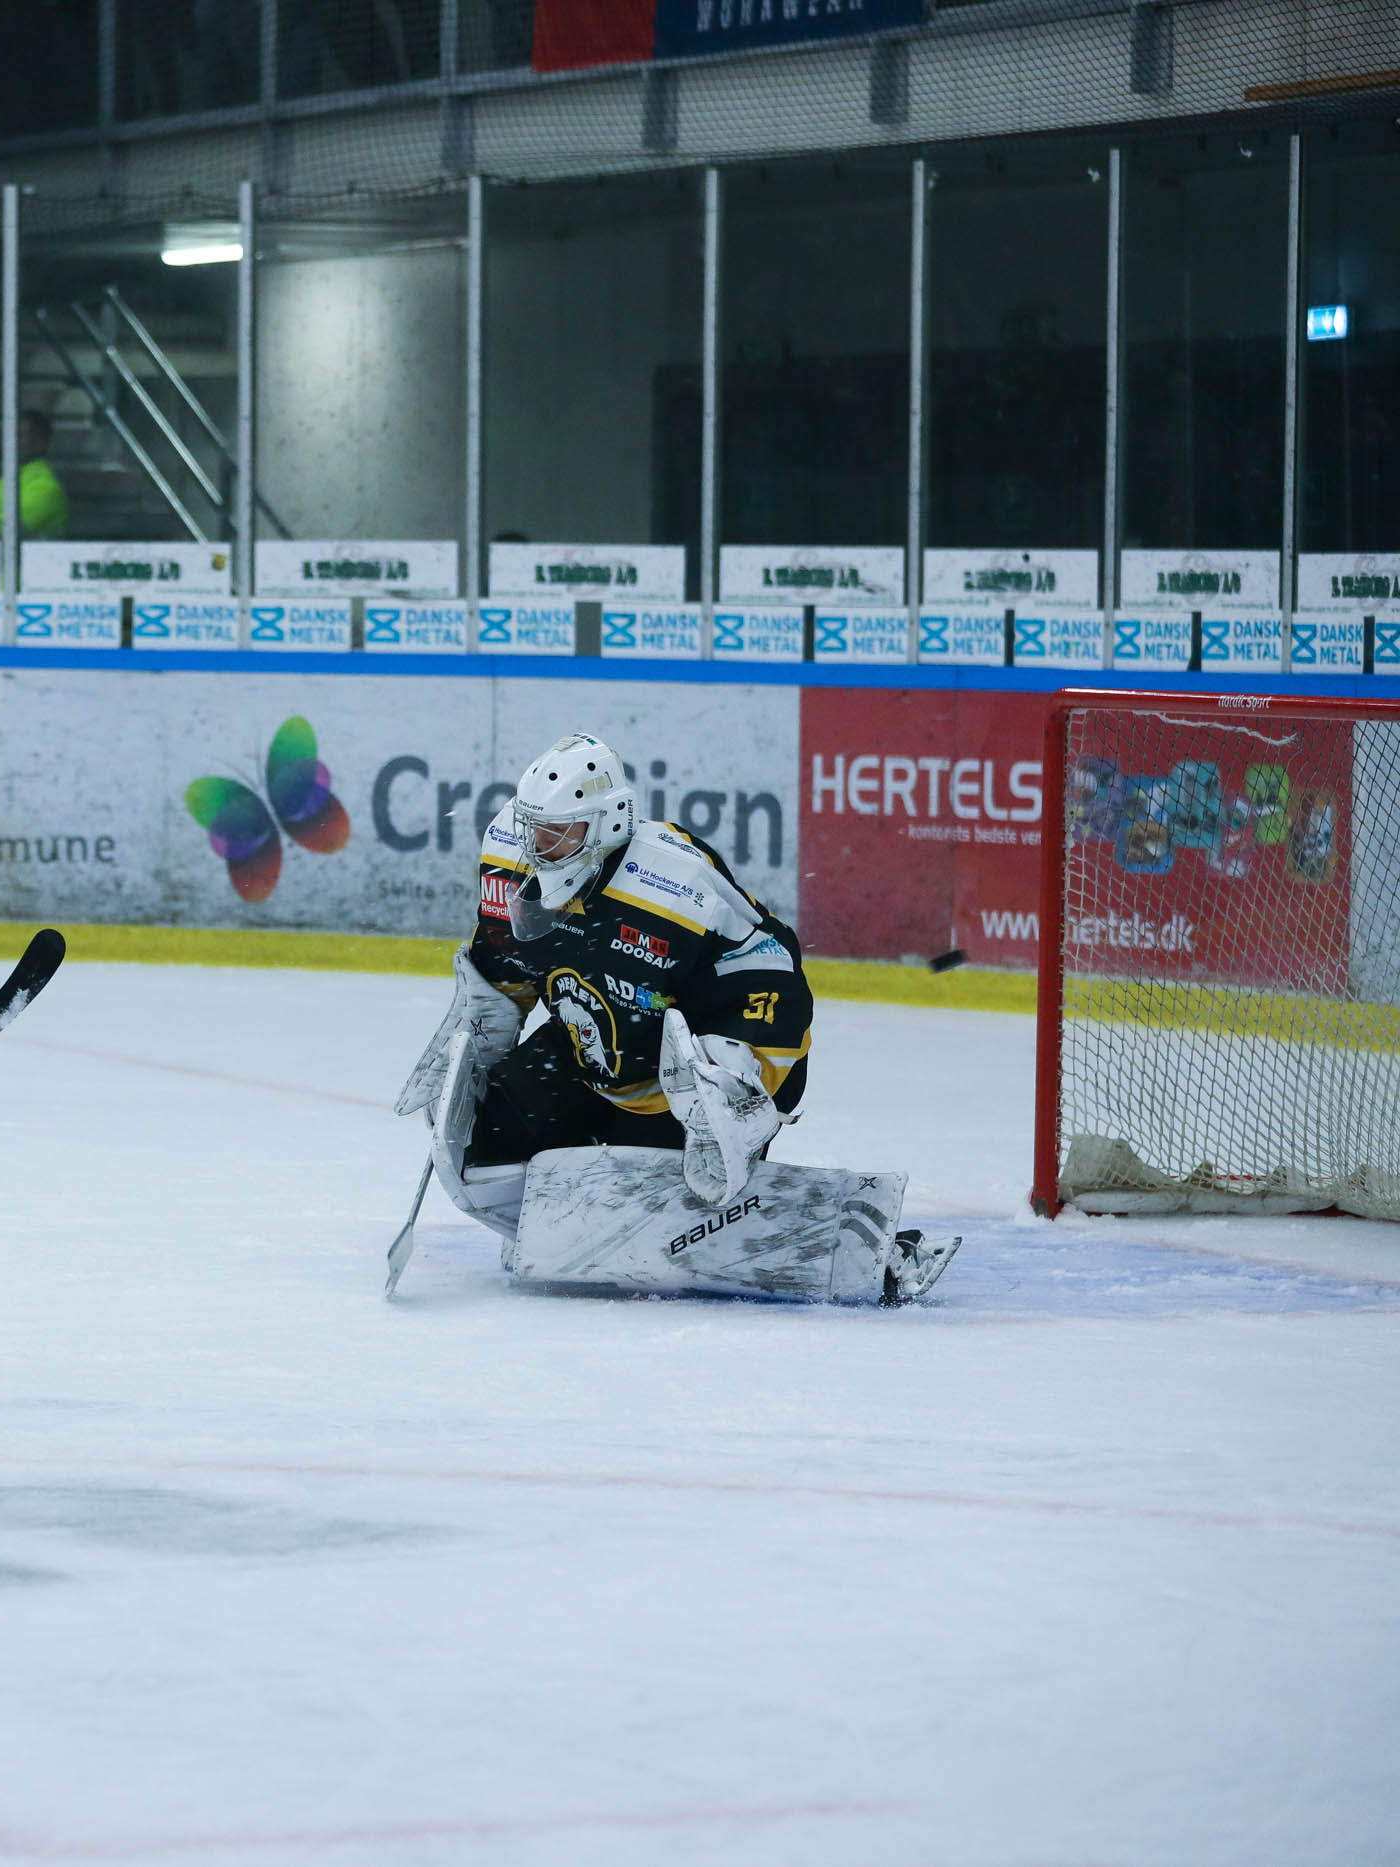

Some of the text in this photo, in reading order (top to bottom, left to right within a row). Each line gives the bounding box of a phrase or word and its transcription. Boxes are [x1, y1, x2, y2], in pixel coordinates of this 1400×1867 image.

[290, 608, 348, 624] DANSK
[406, 609, 464, 625] DANSK
[517, 609, 572, 625] DANSK
[641, 613, 700, 629] DANSK
[750, 616, 800, 632] DANSK
[852, 617, 907, 633] DANSK
[953, 617, 1004, 634] DANSK
[1050, 620, 1102, 638] DANSK
[1144, 622, 1191, 640] DANSK
[1233, 620, 1282, 639] DANSK
[1320, 624, 1363, 642] DANSK
[290, 628, 345, 643] METAL
[405, 628, 463, 645] METAL
[516, 628, 570, 646] METAL
[641, 633, 697, 650] METAL
[750, 636, 799, 653] METAL
[852, 637, 906, 654] METAL
[953, 638, 1001, 655] METAL
[1050, 642, 1100, 660] METAL
[1144, 643, 1189, 662] METAL
[1233, 641, 1281, 661] METAL
[1319, 646, 1361, 665] METAL
[810, 753, 1042, 823] HERTELS
[639, 868, 649, 877] LH
[649, 872, 681, 889] Hockerup
[681, 884, 694, 896] A/S
[610, 938, 676, 969] DOOSAN
[555, 975, 603, 1011] HERLEV
[743, 992, 780, 1024] 51
[669, 1194, 761, 1257] BAUER
